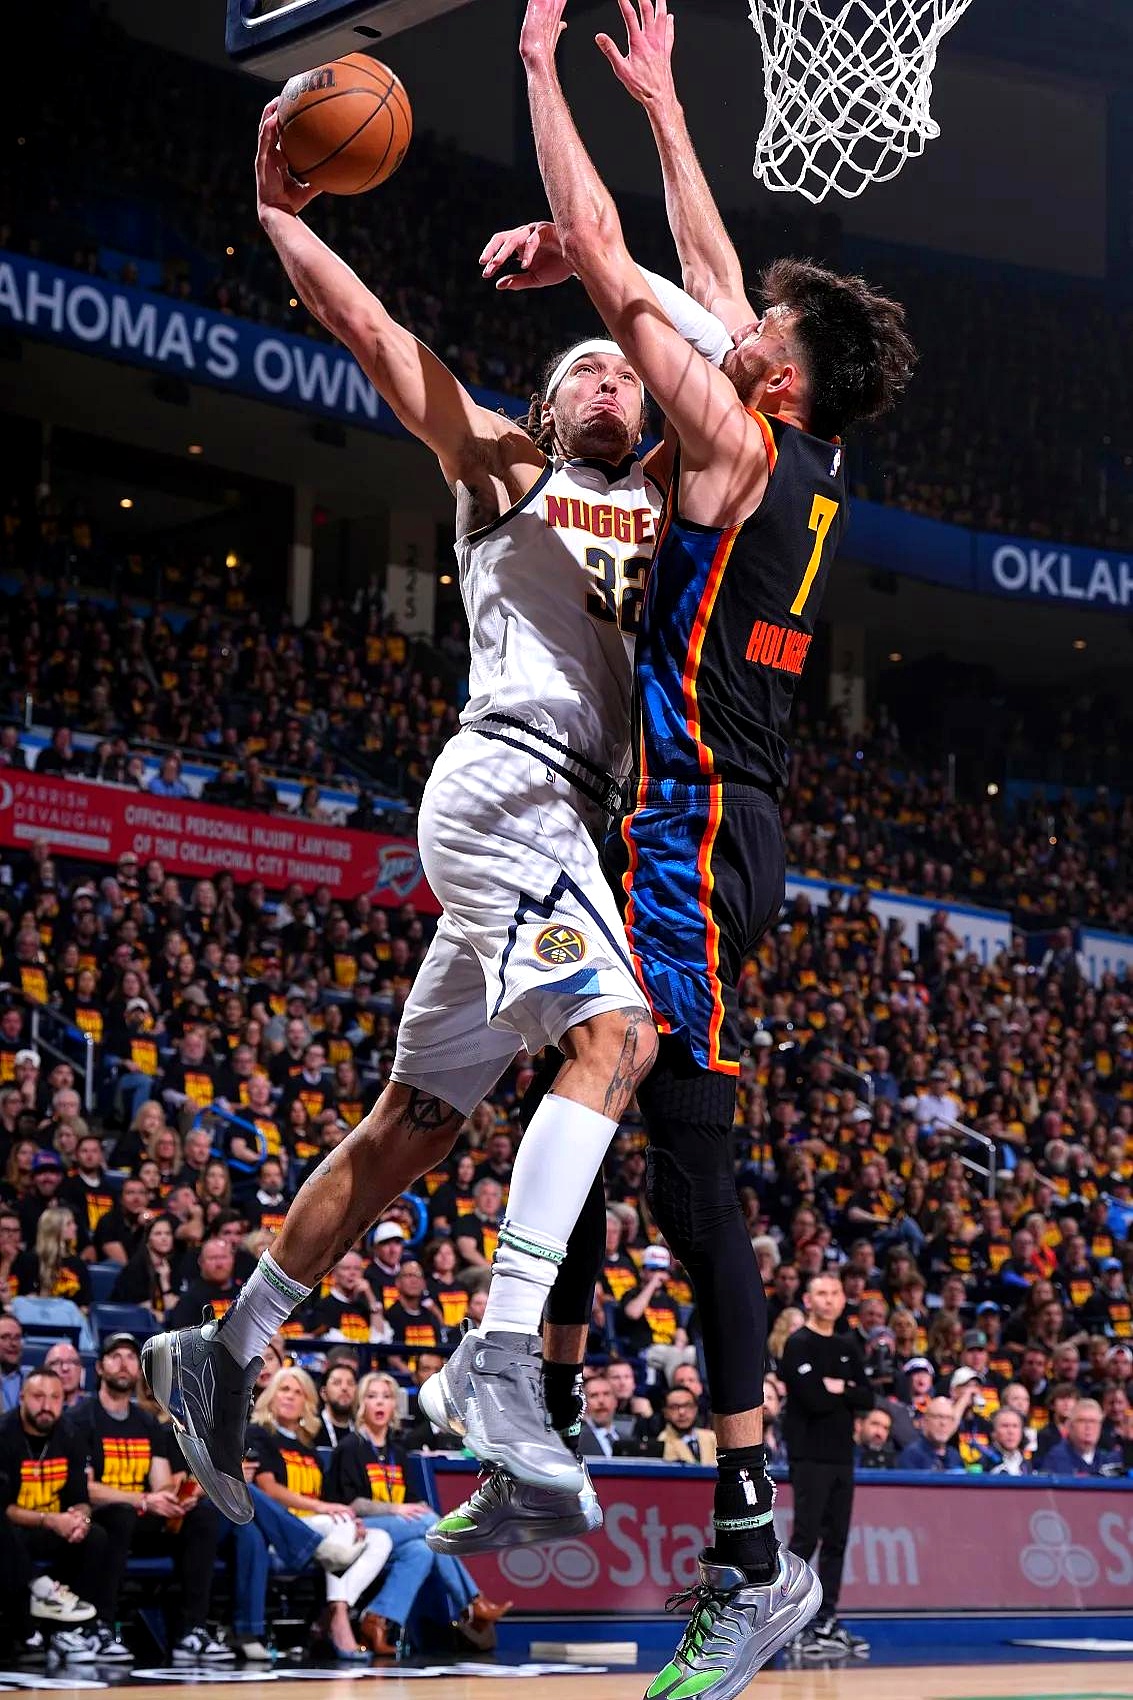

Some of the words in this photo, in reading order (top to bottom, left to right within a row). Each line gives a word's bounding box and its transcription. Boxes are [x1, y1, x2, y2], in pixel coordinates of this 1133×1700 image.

[253, 338, 380, 419] OWN
[545, 494, 659, 545] NUGGE
[789, 493, 840, 617] 7
[584, 546, 652, 635] 32
[124, 804, 182, 833] OFFICIAL
[185, 814, 249, 845] PERSONAL
[251, 825, 295, 853] INJURY
[296, 834, 352, 862] LAWYERS
[133, 832, 151, 854] OF
[154, 836, 178, 859] THE
[180, 841, 253, 871] OKLAHOMA
[255, 853, 284, 877] CITY
[286, 859, 343, 886] THUNDER
[605, 1502, 715, 1588] Sta
[1099, 1510, 1133, 1585] S
